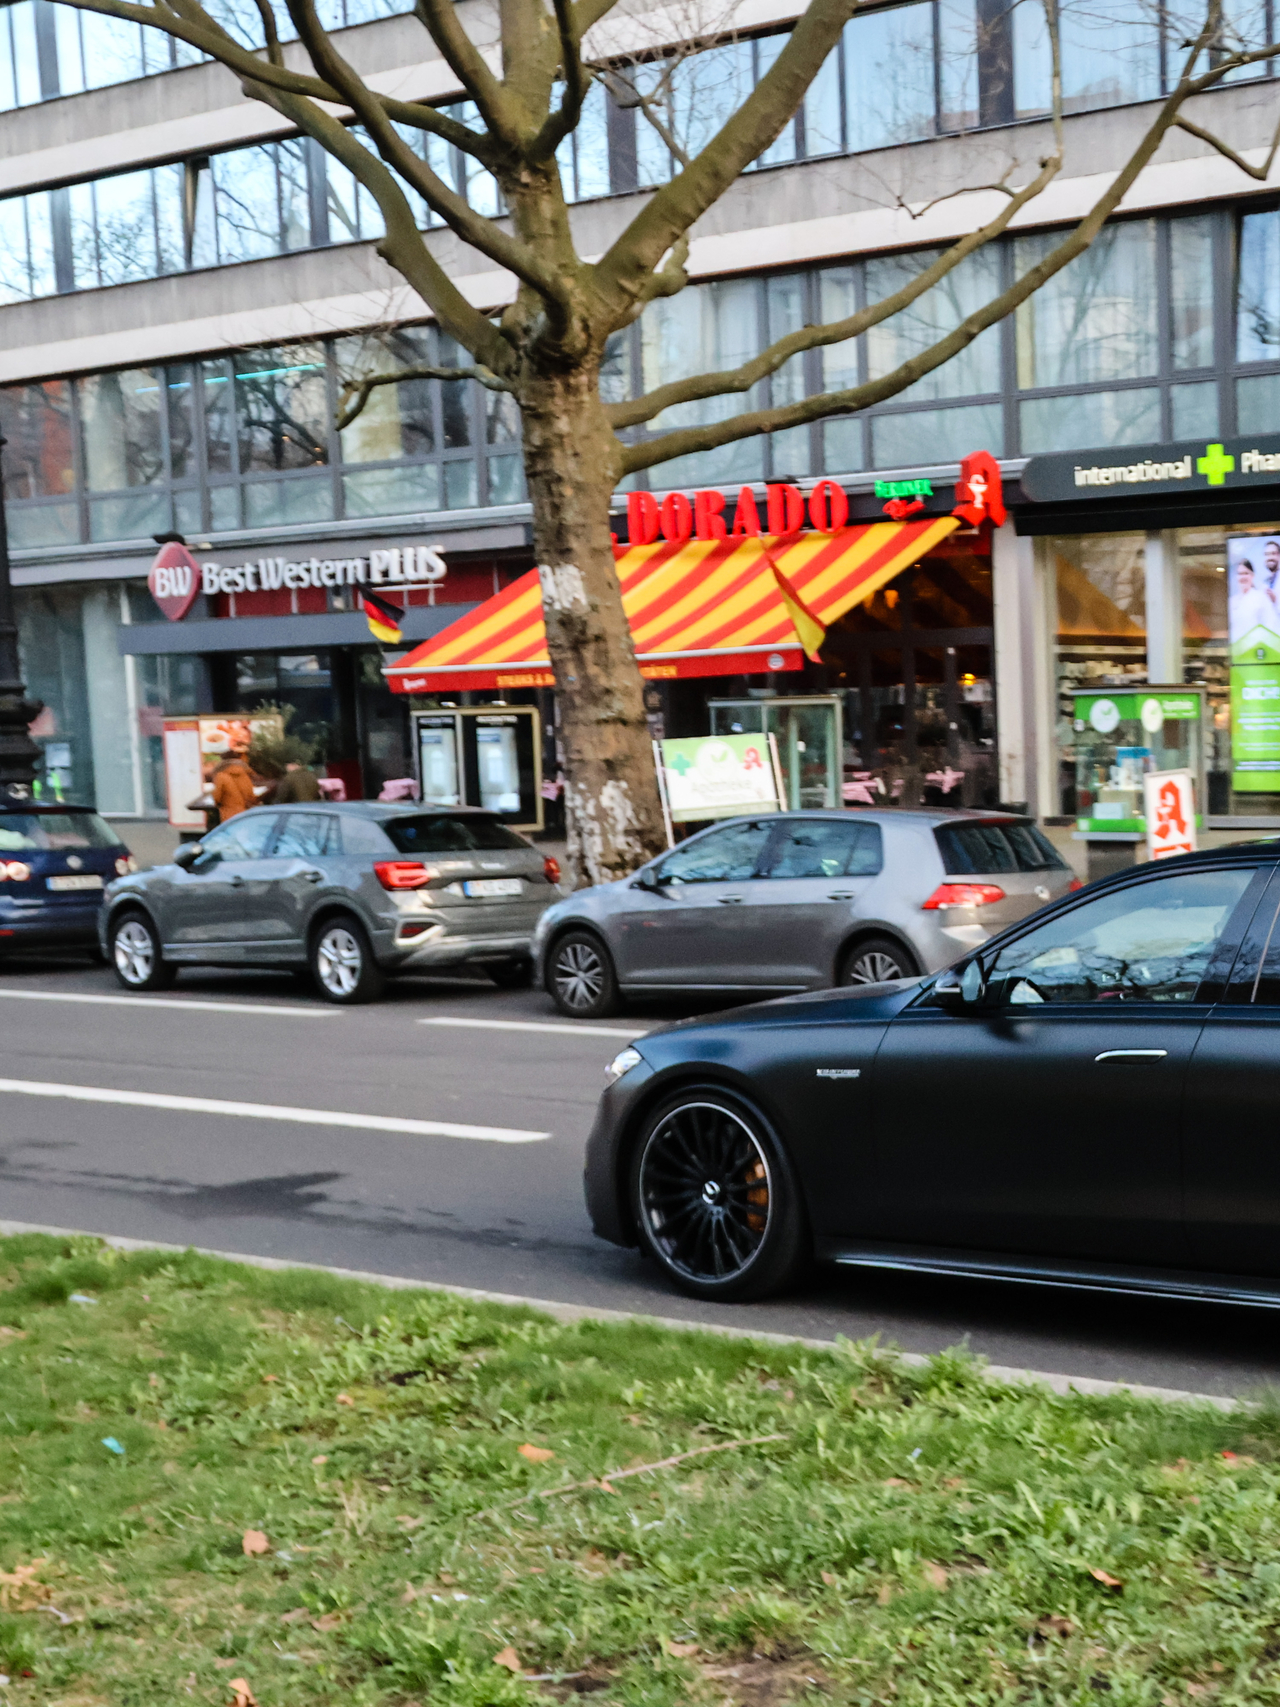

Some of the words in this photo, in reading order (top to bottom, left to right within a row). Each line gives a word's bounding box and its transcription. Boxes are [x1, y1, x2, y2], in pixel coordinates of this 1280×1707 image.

[1073, 454, 1192, 486] international
[625, 479, 850, 546] DORADO
[154, 565, 192, 598] BW
[202, 561, 257, 595] Best
[257, 556, 367, 591] Western
[368, 544, 448, 583] PLUS
